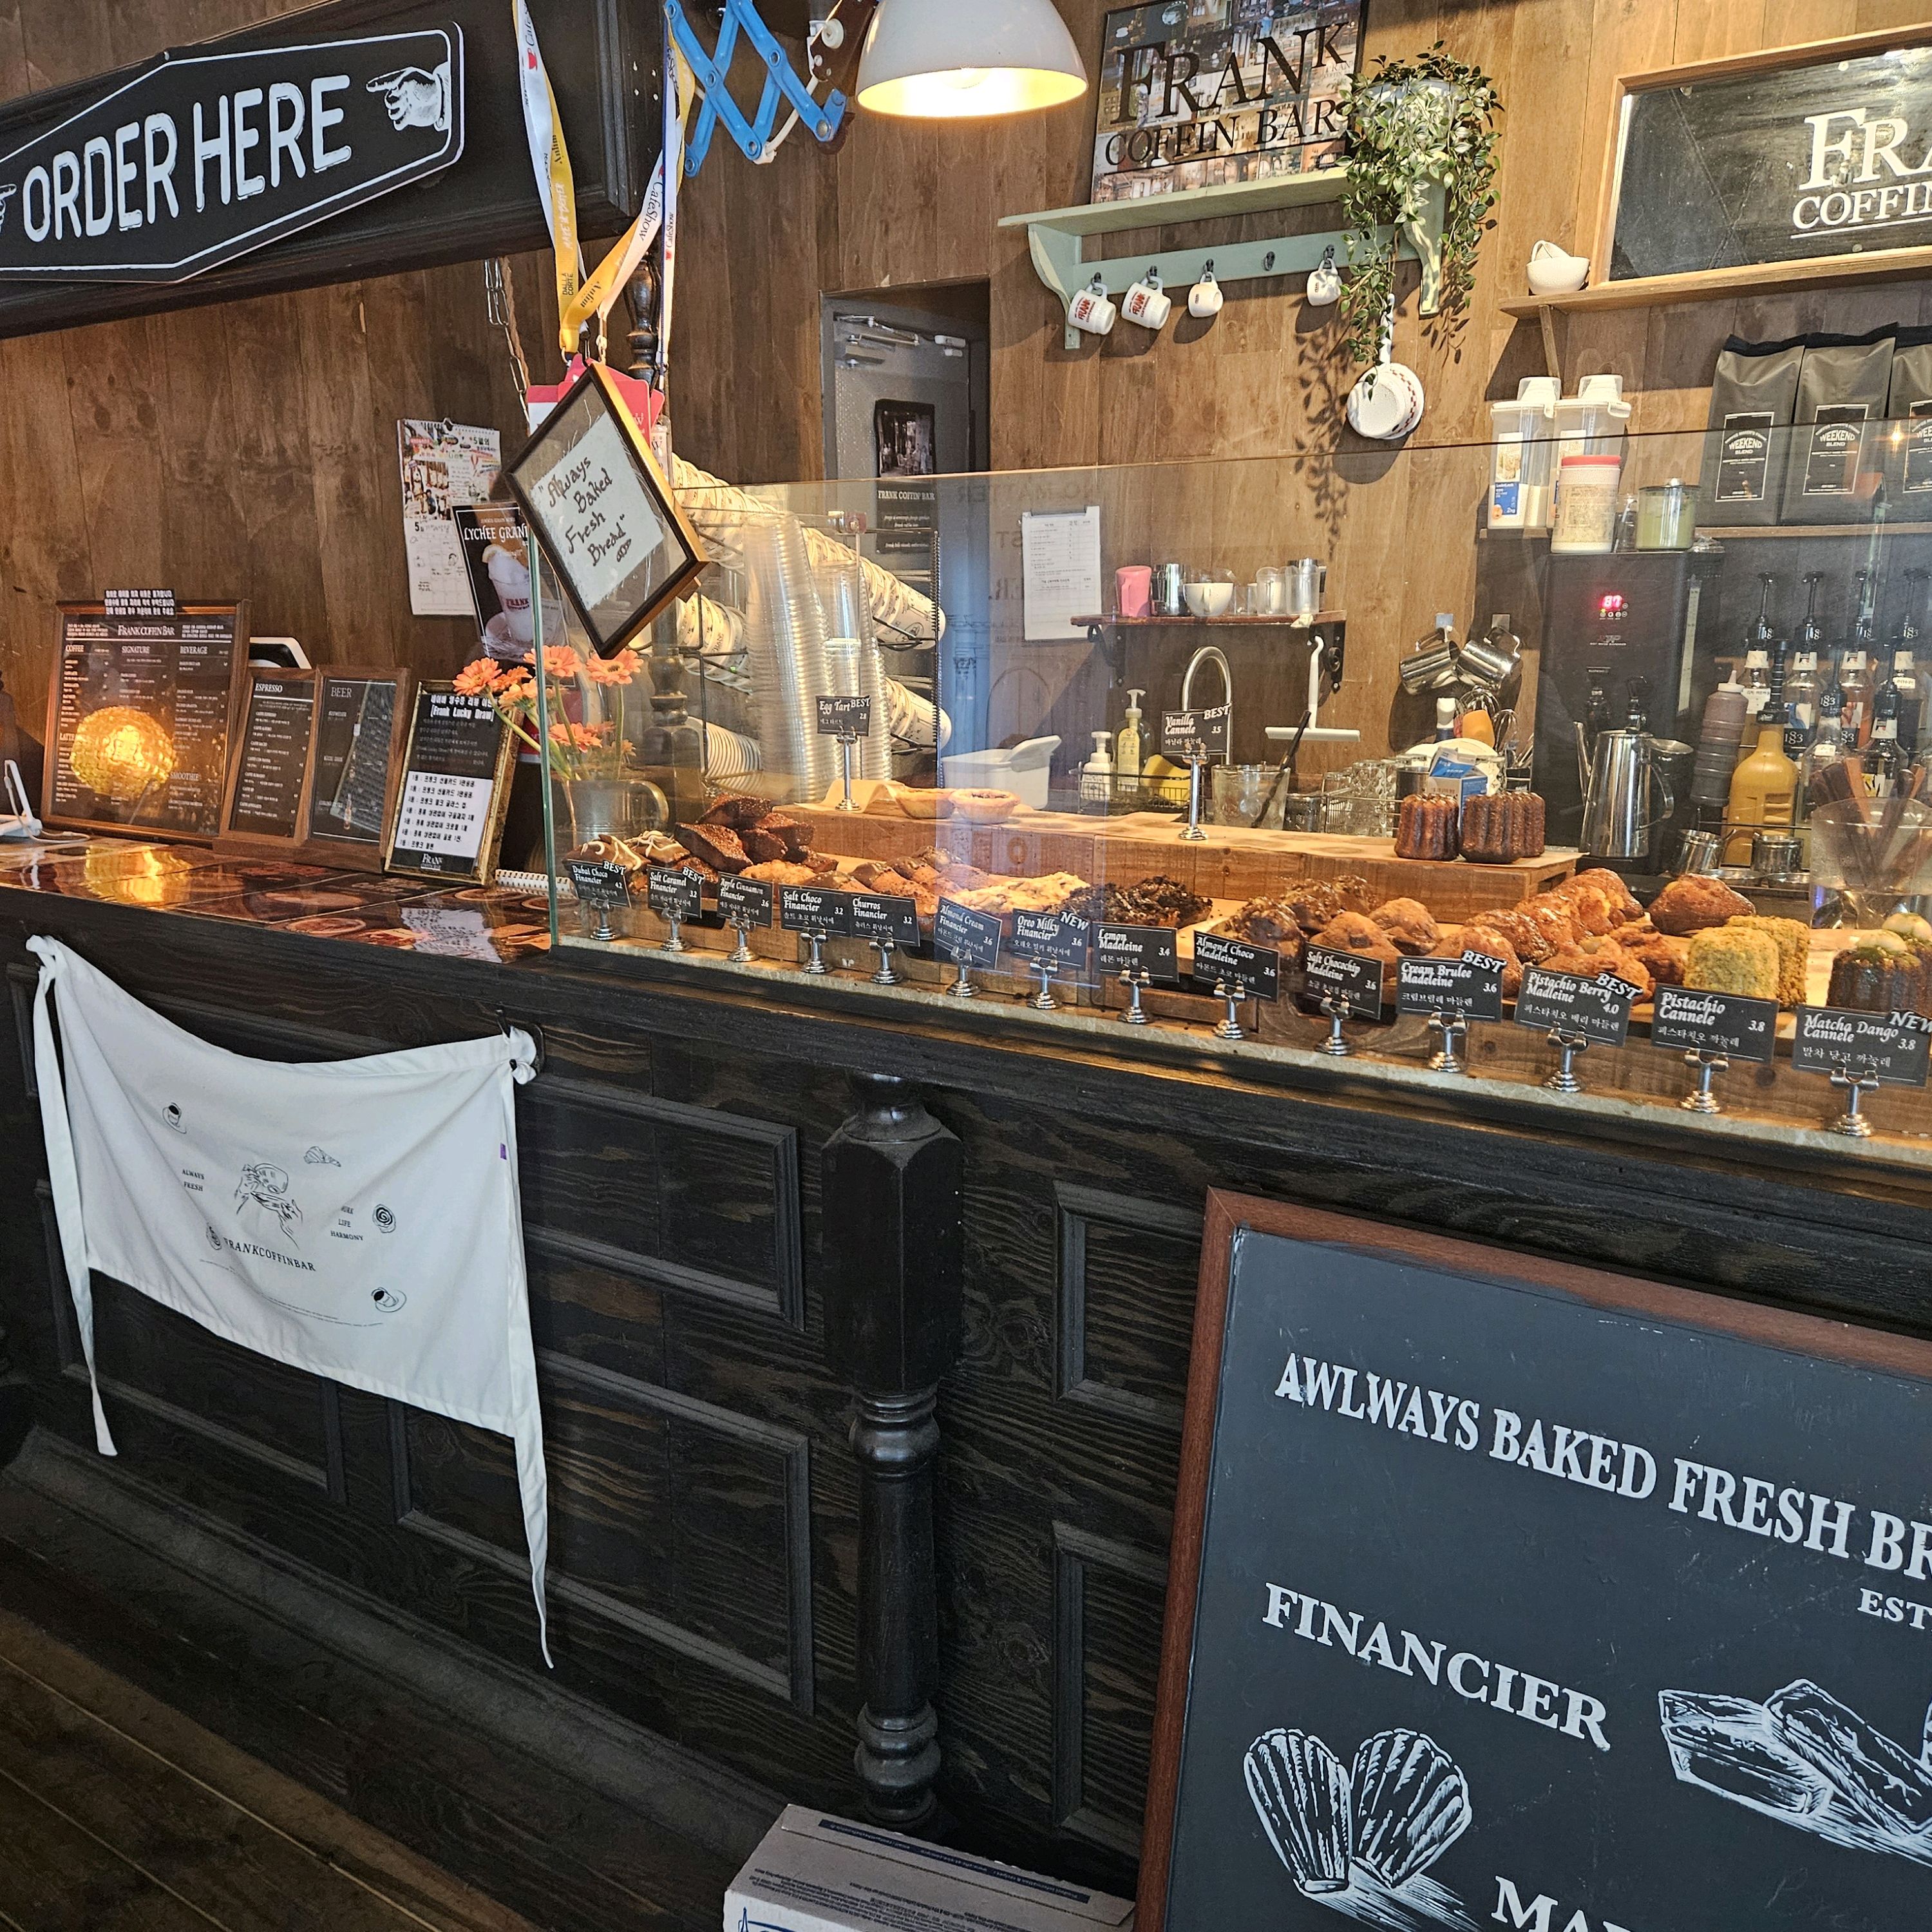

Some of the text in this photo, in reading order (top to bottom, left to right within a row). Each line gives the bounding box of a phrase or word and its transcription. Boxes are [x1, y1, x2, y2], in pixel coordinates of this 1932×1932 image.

[1110, 22, 1349, 125] FRANK
[1106, 99, 1340, 166] COFFIN BAR
[1799, 108, 1932, 190] FR
[23, 75, 352, 243] ORDER HERE
[639, 181, 663, 242] CafeShow
[666, 211, 676, 249] CafeShow
[1728, 437, 1763, 450] WEEKEND
[1819, 430, 1855, 442] WEEKEND
[572, 467, 614, 514] Baked
[464, 524, 497, 541] LYCHEE
[565, 509, 606, 555] Fresh
[121, 645, 151, 654] SIGNATURE
[180, 646, 208, 655] BEVERAGE
[255, 683, 283, 693] ESPRESSO
[330, 687, 352, 698] BEER
[819, 699, 851, 715] Egg Tart
[851, 697, 871, 708] BEST
[1204, 701, 1232, 720] BEST
[1166, 714, 1195, 728] Vanilla
[1165, 725, 1196, 735] Cannele
[572, 865, 609, 878] Dubai Choco
[603, 860, 627, 876] BEST
[574, 873, 603, 885] Financier
[650, 871, 687, 887] Salt Caramel
[683, 867, 705, 885] BEST
[650, 881, 677, 894] Financier
[720, 878, 764, 895] Apple Cinnamon
[720, 888, 745, 901] Financier
[783, 891, 822, 904] Salt Choco
[784, 900, 820, 913] Financier
[835, 907, 844, 915] 3.2
[852, 897, 882, 910] Churros
[853, 907, 888, 920] Financier
[903, 916, 913, 925] 3.2
[940, 904, 985, 931] Almond Cream
[1060, 911, 1090, 931] NEW
[939, 915, 968, 934] Financier
[1017, 915, 1060, 936] Oreo Milky
[1016, 925, 1053, 941] Financier
[1097, 928, 1127, 942] Lemon
[983, 936, 993, 946] 3.6
[1071, 937, 1083, 947] 3.6
[1098, 938, 1144, 953] Madeleine
[1196, 936, 1255, 960] Almond Choco
[1158, 947, 1170, 956] 3.4
[1196, 947, 1238, 966] Madeleine
[1461, 950, 1507, 974] BEST
[1263, 967, 1276, 978] 3.6
[1306, 961, 1344, 981] Madeleine
[1401, 961, 1472, 979] Cream Brulee
[1401, 972, 1454, 987] Madeleine
[1528, 971, 1612, 1003] Pistachio Berry
[1595, 972, 1643, 999] BEST
[1482, 983, 1498, 993] 3.6
[1602, 1003, 1620, 1014] 4.0
[1660, 992, 1726, 1015] Pistachio
[1660, 1005, 1716, 1027] Cannele
[1748, 1019, 1766, 1032] 3.8
[1803, 1014, 1899, 1043] Matcha Dango
[1803, 1027, 1855, 1044] Cannele
[1897, 1037, 1917, 1050] 3.8
[1803, 1046, 1826, 1059] 말차
[182, 1168, 205, 1180] ALWAYS
[183, 1181, 204, 1192] FRESH
[337, 1218, 352, 1228] LIFE
[330, 1229, 365, 1242] HARMONY
[1274, 1352, 1480, 1452] AWLWAYS
[1490, 1406, 1658, 1501] BAKED
[1668, 1456, 1855, 1560] FRESH
[1261, 1581, 1612, 1753] FINANCIER
